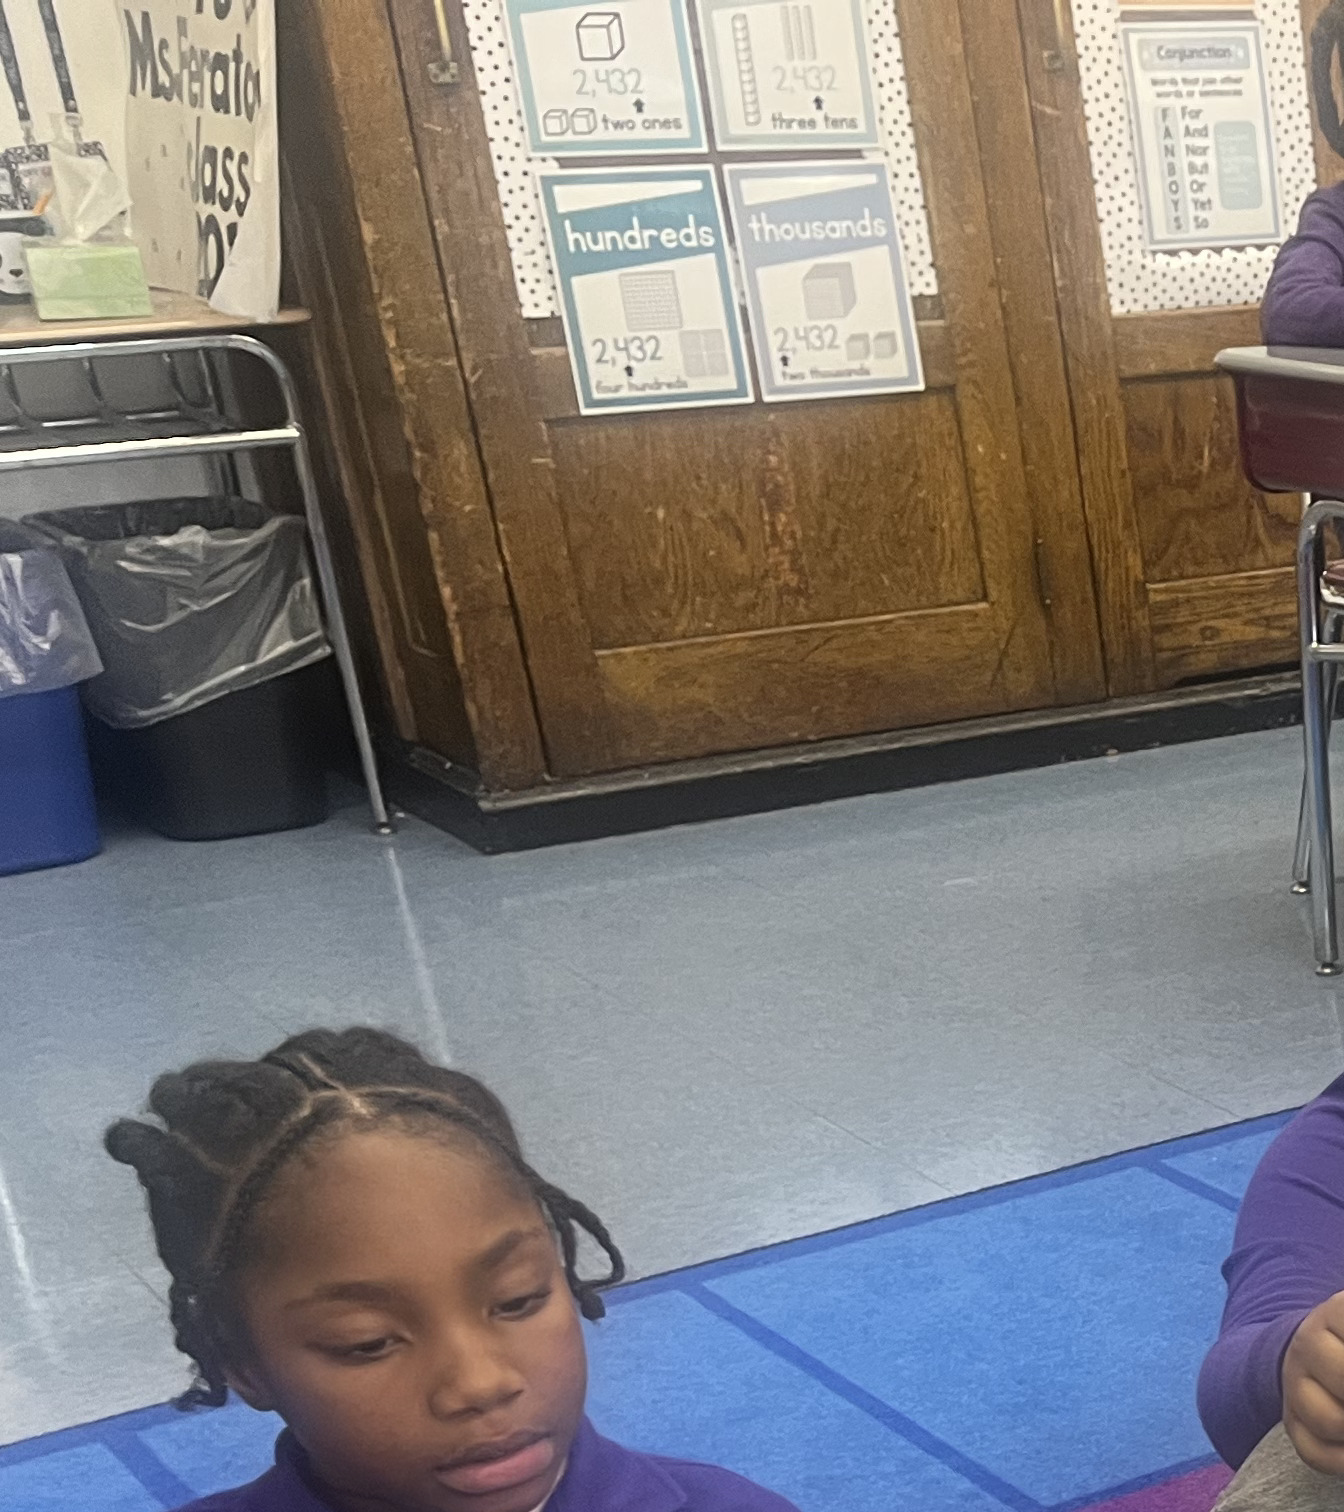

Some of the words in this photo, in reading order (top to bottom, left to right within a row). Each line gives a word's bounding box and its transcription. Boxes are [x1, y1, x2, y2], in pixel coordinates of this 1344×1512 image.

[572, 68, 644, 97] 2,432
[772, 65, 839, 93] 2,432
[601, 113, 636, 131] two
[641, 117, 682, 131] ones
[771, 111, 817, 130] three
[824, 112, 858, 130] tens
[563, 213, 715, 253] hundreds
[747, 207, 887, 242] thousands
[592, 334, 664, 367] 2,432
[773, 324, 840, 355] 2,432
